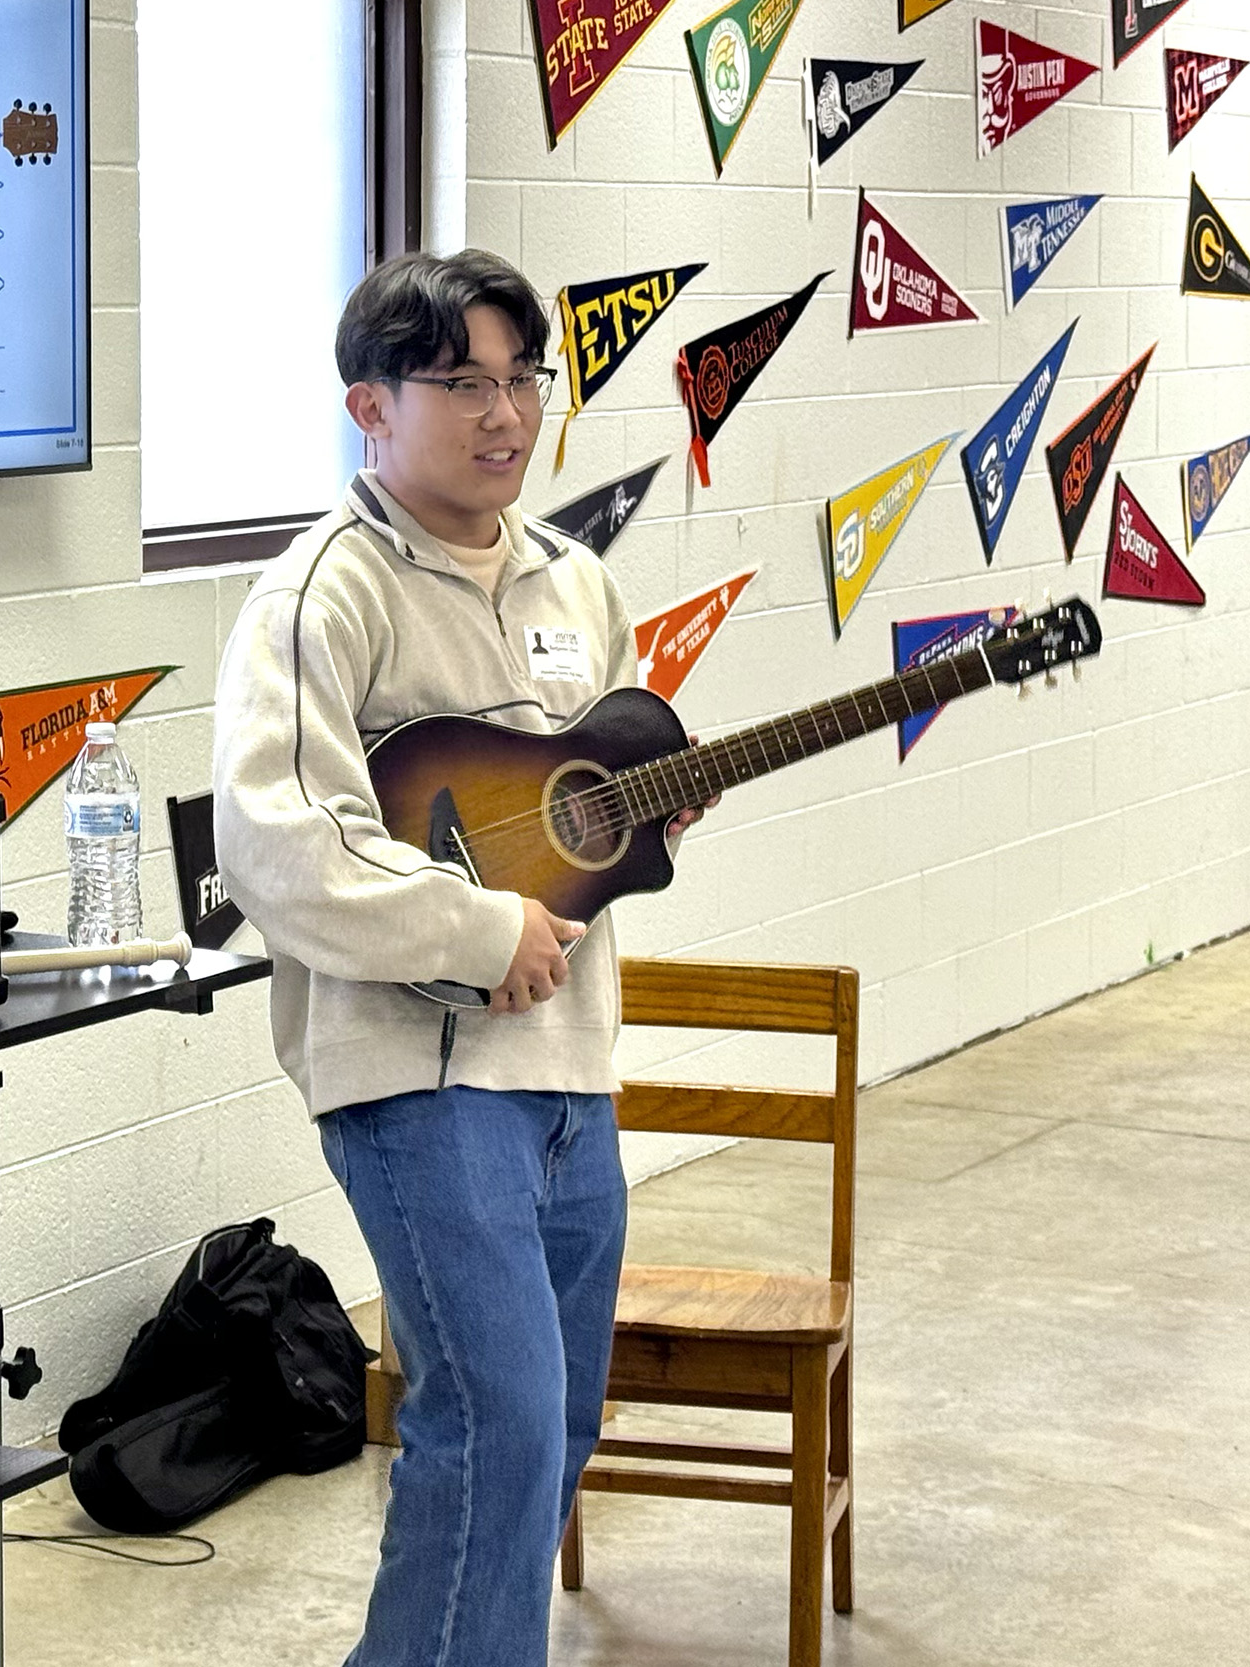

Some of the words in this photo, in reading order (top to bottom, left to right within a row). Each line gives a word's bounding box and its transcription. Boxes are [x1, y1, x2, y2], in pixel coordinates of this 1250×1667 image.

[546, 17, 609, 87] STATE
[892, 262, 938, 300] OKLAHOMA
[895, 284, 933, 318] SOONERS
[576, 271, 675, 382] ETSU
[728, 304, 788, 364] TUSCULUM
[730, 329, 778, 384] COLLEGE
[1005, 364, 1051, 460] CREIGHTON
[869, 464, 915, 531] SOUTHERN
[676, 596, 717, 645] UNIVERSITY
[686, 621, 710, 653] TEXAS
[20, 698, 89, 750] FLORIDA
[88, 681, 118, 716] A&M
[27, 706, 118, 761] RATTLRS
